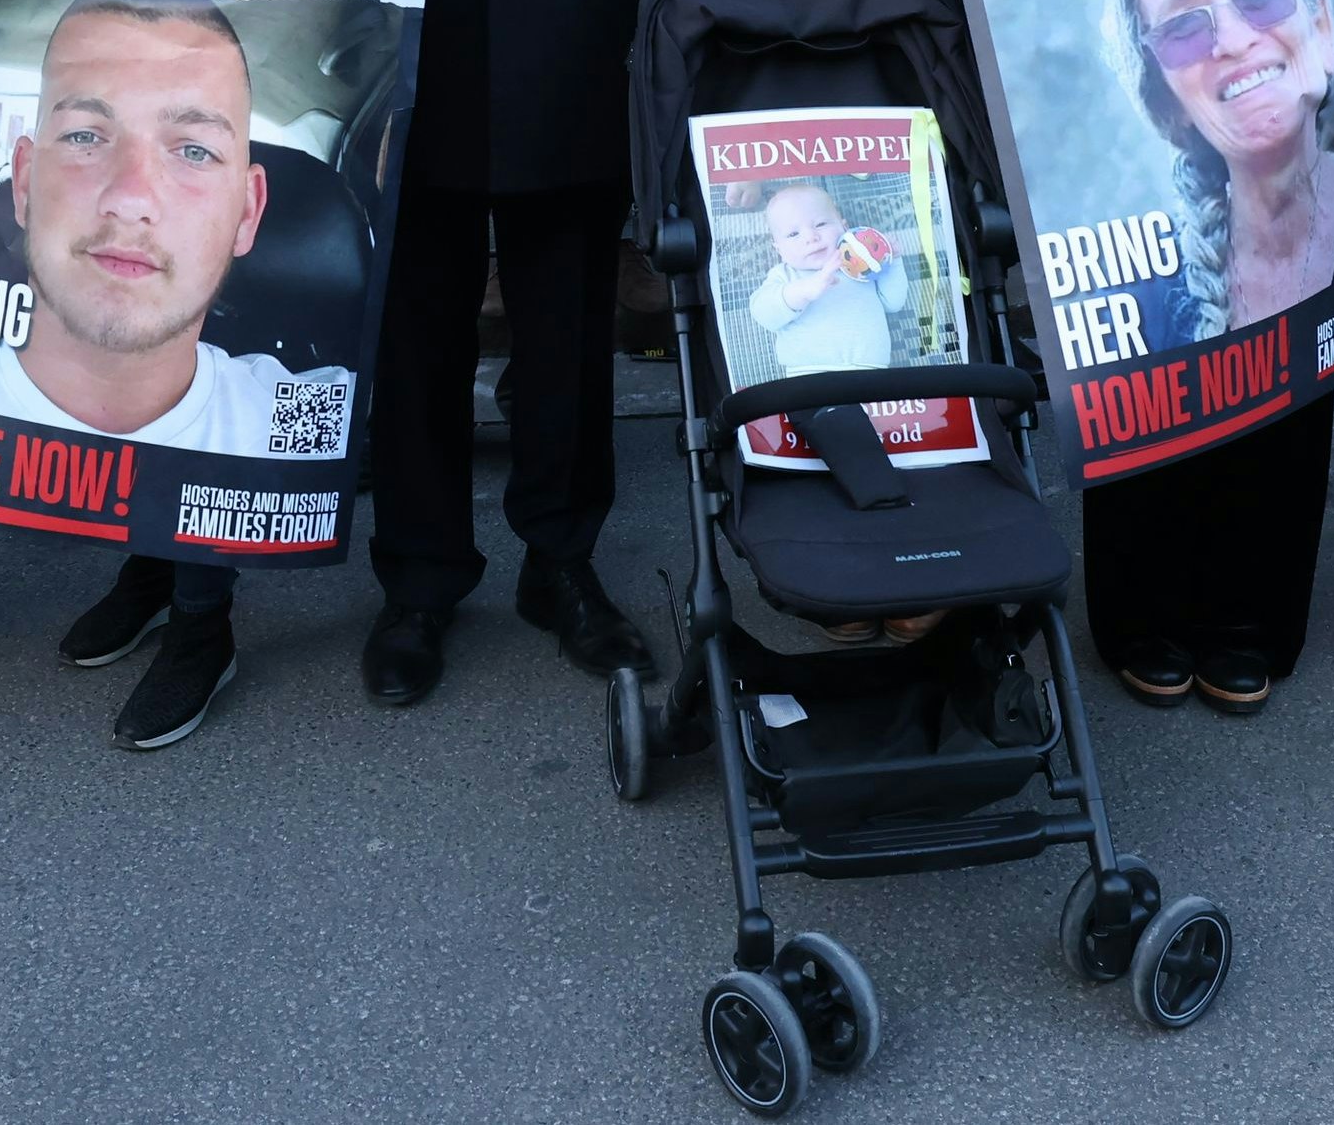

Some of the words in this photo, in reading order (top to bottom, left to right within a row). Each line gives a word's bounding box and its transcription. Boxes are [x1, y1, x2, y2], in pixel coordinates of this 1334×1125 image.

[1038, 211, 1180, 298] BRING
[1053, 292, 1150, 371] HER
[1070, 360, 1191, 450] HOME
[1200, 316, 1291, 418] NOW!
[786, 431, 798, 449] 9
[890, 423, 923, 444] old
[12, 432, 137, 517] NOW!
[181, 483, 248, 511] HOSTAGES
[251, 491, 281, 513] AND
[282, 492, 339, 513] MISSING
[177, 506, 266, 543] FAMILIES
[269, 512, 336, 543] FORUM
[895, 550, 962, 562] MAXI-COSI
